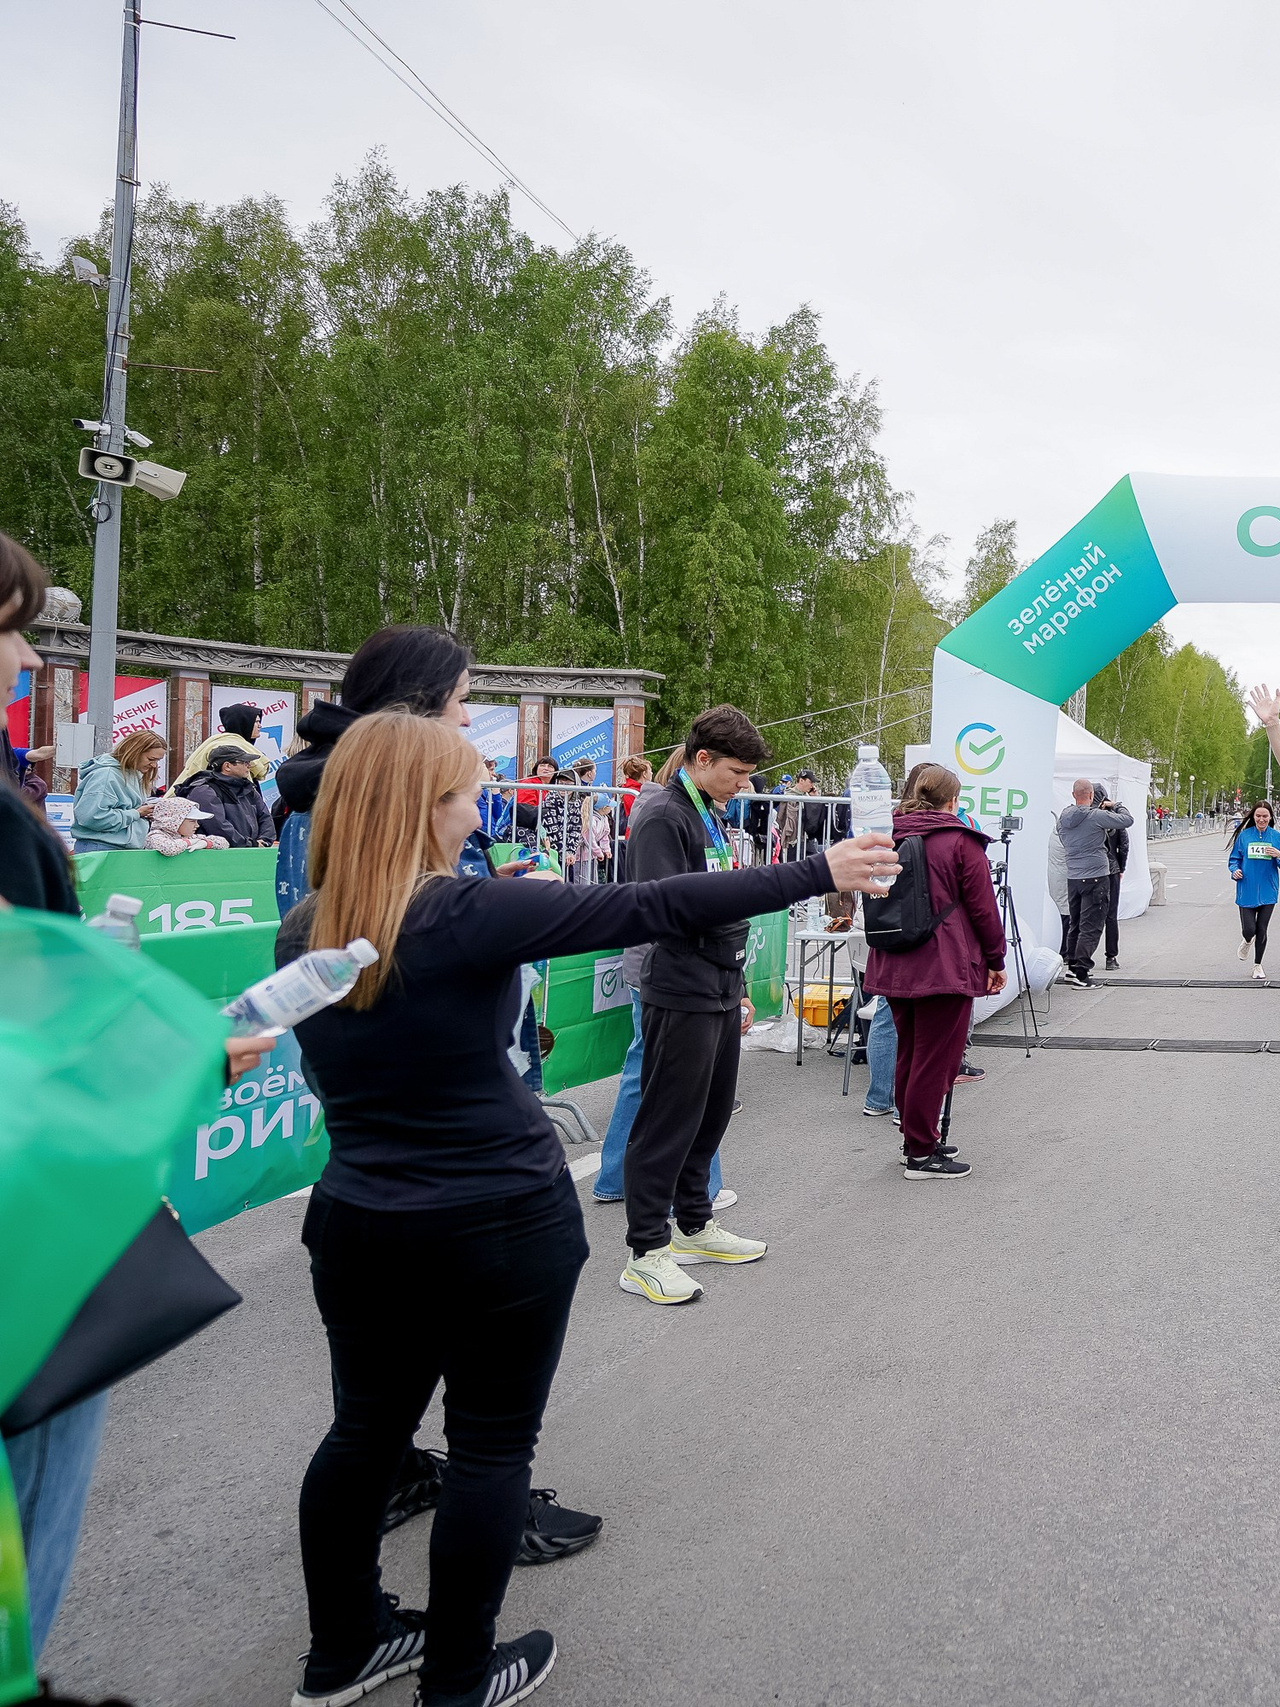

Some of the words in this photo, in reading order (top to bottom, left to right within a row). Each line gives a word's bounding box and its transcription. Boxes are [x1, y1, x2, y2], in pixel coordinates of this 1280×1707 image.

[1007, 541, 1107, 636] зелёный
[1022, 563, 1123, 655] марафон
[113, 699, 159, 725] ЖЕНИЕ
[477, 710, 513, 730] ВМЕСТЕ
[556, 714, 600, 740] ФЕСТИВАЛЬ
[112, 714, 162, 744] РВЫХ
[477, 738, 496, 750] ЫТЬ
[482, 739, 511, 756] ССИЕЙ
[558, 732, 608, 763] ДВИЖЕНИЕ
[959, 785, 1028, 816] БЕР
[1250, 846, 1266, 854] 141
[148, 898, 254, 933] 185
[195, 1093, 322, 1181] рит
